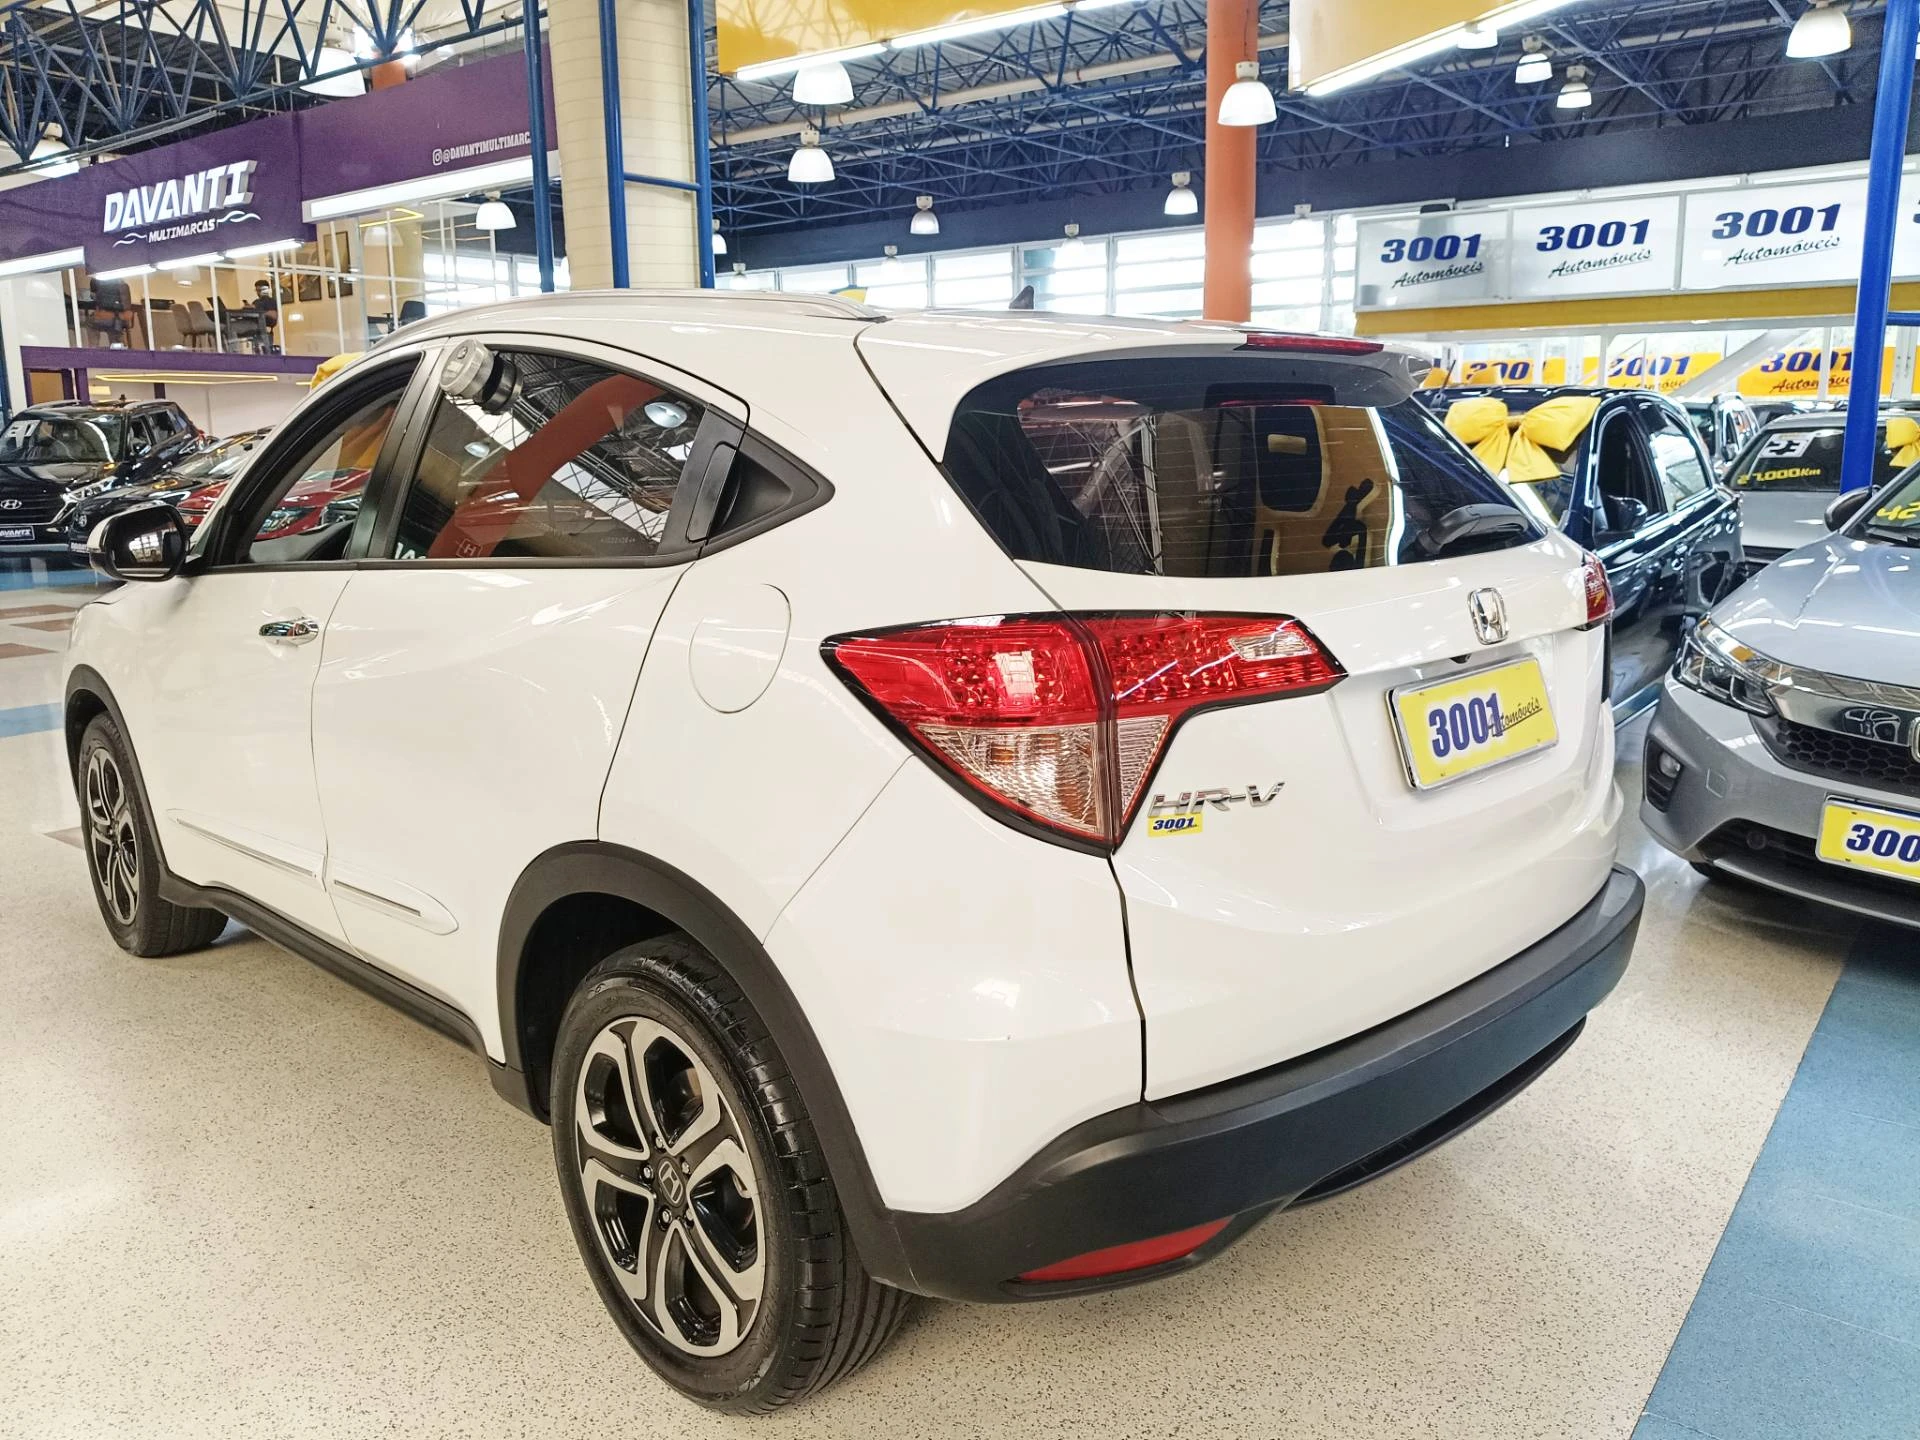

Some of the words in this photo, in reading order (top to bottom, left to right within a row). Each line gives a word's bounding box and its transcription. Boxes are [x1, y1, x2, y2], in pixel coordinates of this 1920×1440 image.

[443, 131, 531, 163] @DAVANTIMULTIMARC
[103, 160, 257, 233] DAVANTI
[148, 218, 216, 243] MULTIMARCAS
[1536, 218, 1650, 252] 3001
[1712, 203, 1841, 239] 3001
[1381, 233, 1481, 263] 3001
[1428, 692, 1503, 758] 3001
[1147, 780, 1286, 817] HR-V
[1152, 816, 1195, 831] 3001
